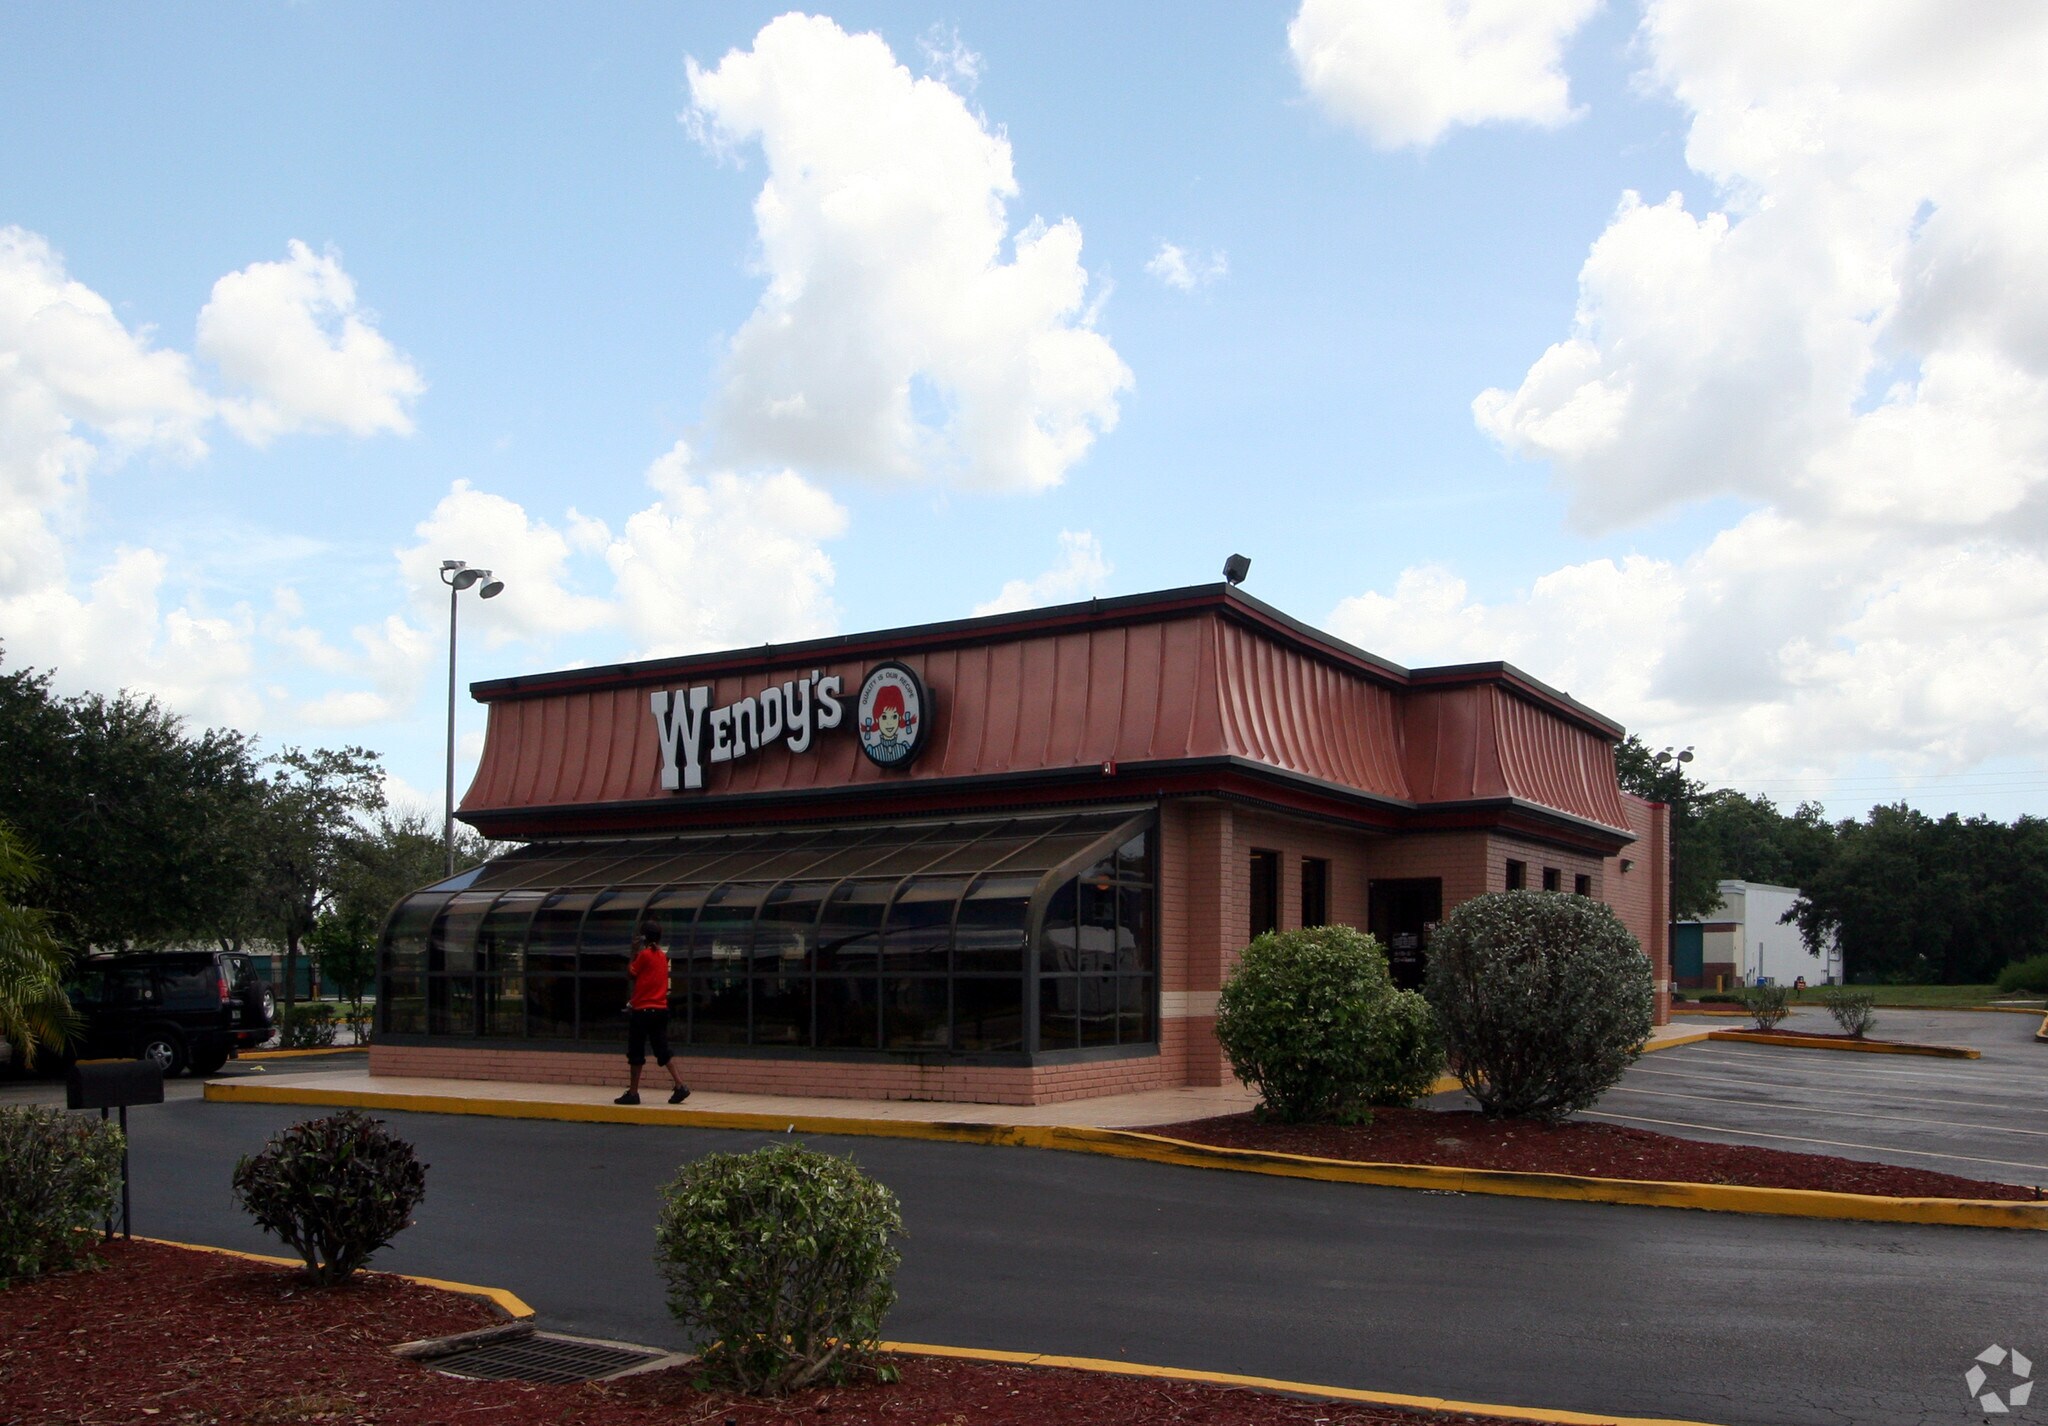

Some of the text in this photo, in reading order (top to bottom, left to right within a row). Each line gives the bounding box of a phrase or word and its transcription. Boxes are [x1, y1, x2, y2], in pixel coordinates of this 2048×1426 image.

[862, 679, 877, 705] QUALITY
[886, 671, 898, 679] OUR
[899, 677, 914, 699] RECIPE
